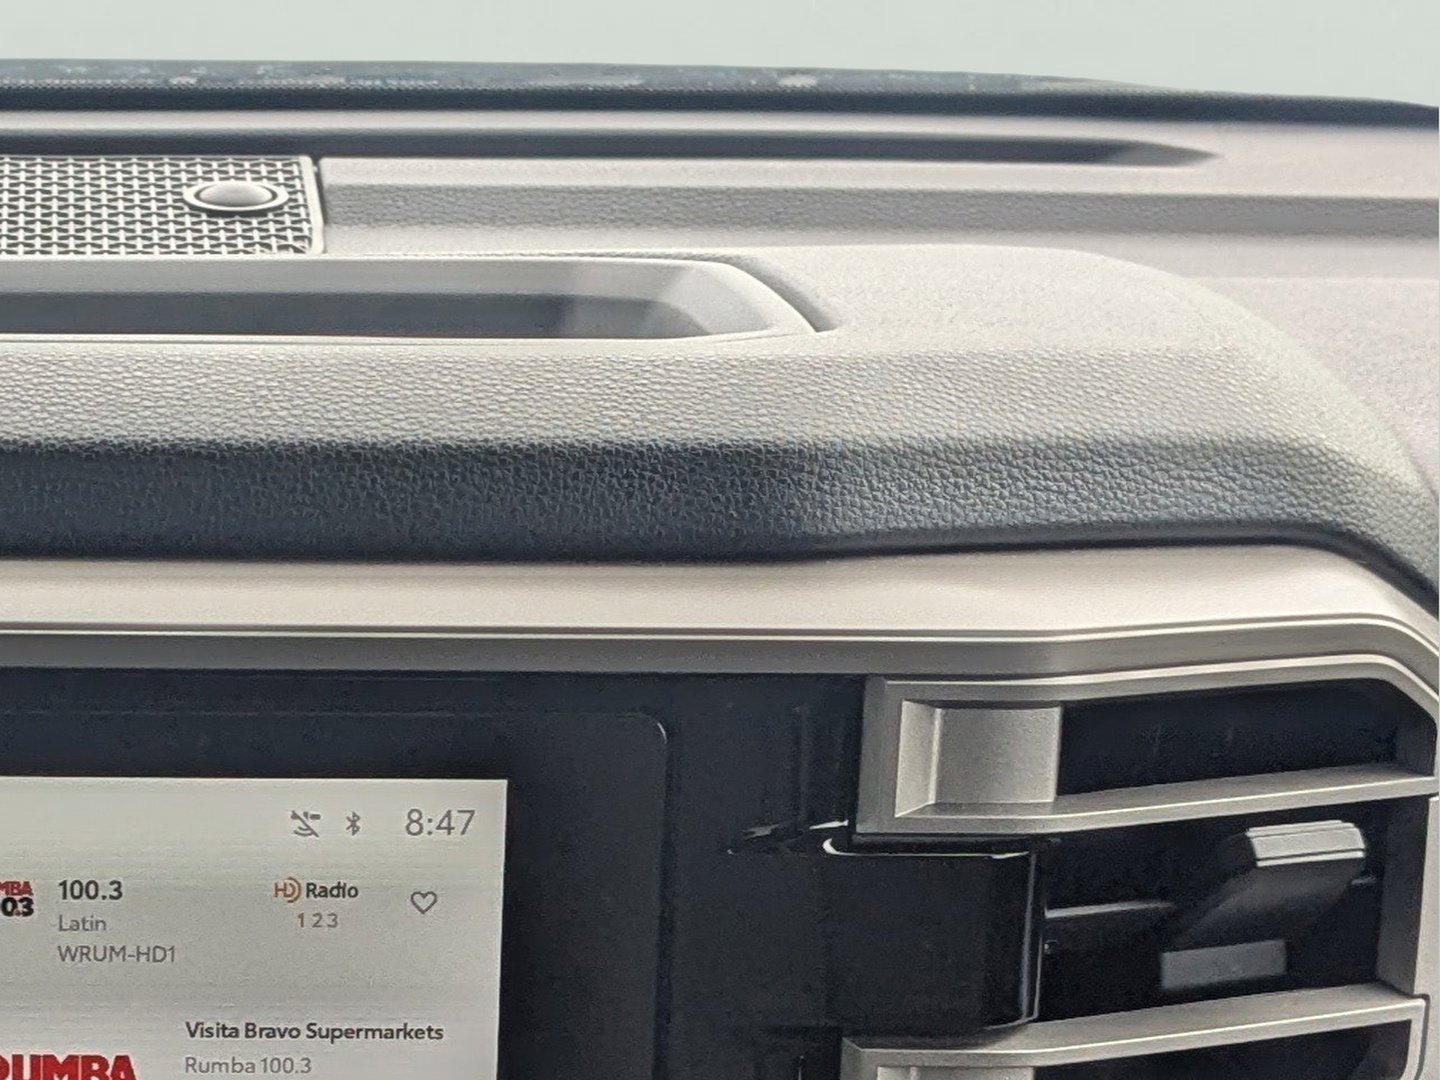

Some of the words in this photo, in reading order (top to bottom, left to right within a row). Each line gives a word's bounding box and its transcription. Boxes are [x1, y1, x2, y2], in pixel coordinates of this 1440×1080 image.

[405, 809, 477, 837] 8:47
[58, 880, 124, 900] 100.3
[305, 881, 359, 900] Radio
[58, 914, 107, 932] Latin
[58, 944, 177, 964] WRUM-HD1
[185, 1021, 240, 1040] Visita
[244, 1022, 301, 1041] Bravo
[306, 1022, 445, 1044] Supermarkets
[185, 1056, 256, 1074] Rumba
[260, 1057, 313, 1075] 100.3
